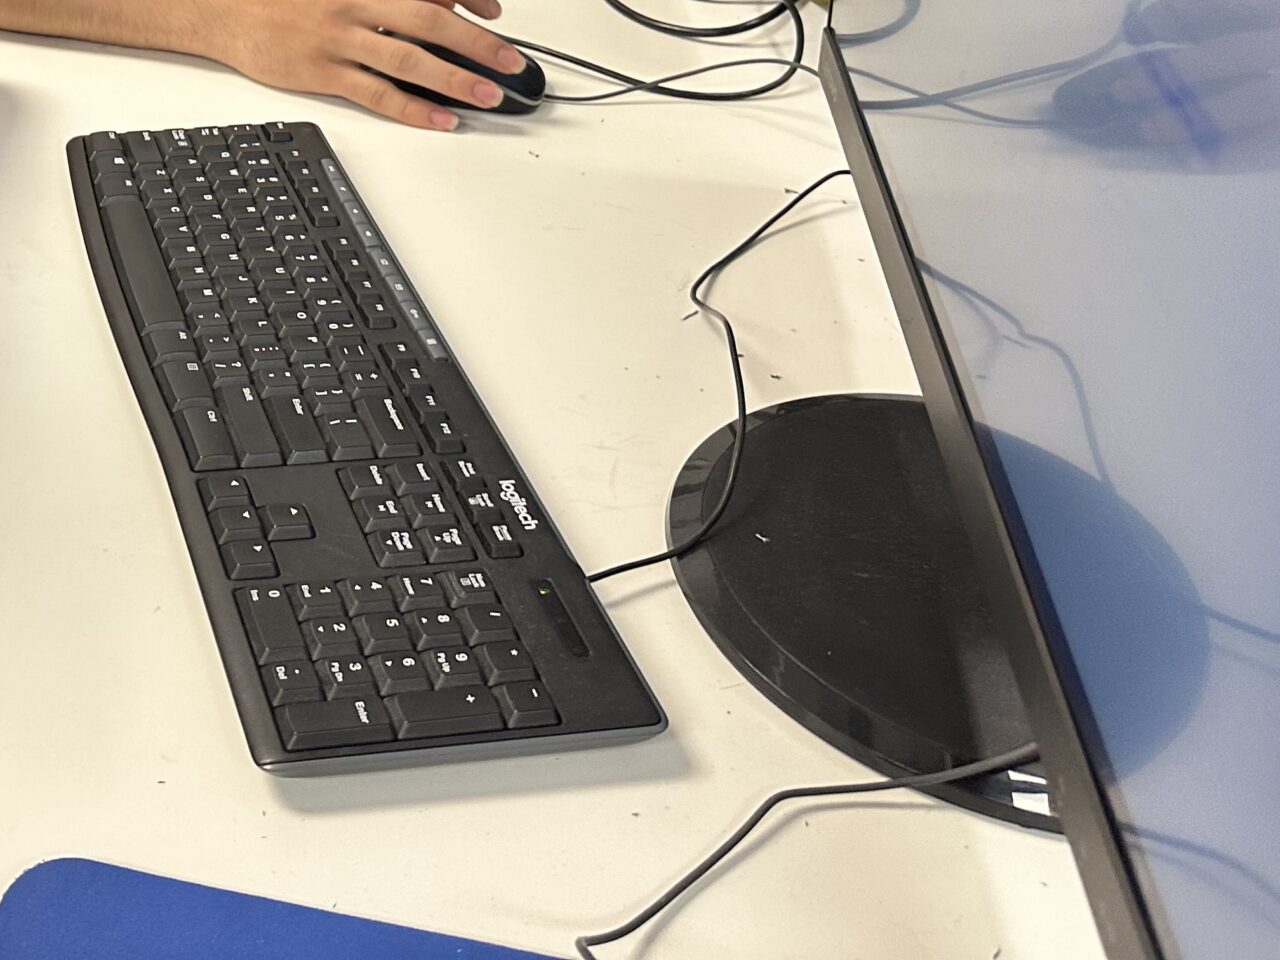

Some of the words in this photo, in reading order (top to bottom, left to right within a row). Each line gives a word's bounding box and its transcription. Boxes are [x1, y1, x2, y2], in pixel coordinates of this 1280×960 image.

[498, 480, 539, 531] logitech
[370, 582, 382, 590] 4
[420, 578, 432, 586] 7
[268, 590, 280, 598] 0
[386, 618, 400, 626] 5
[438, 614, 450, 622] 8
[332, 624, 346, 632] 2
[456, 652, 468, 662] 9
[348, 662, 362, 670] 3
[402, 658, 416, 666] 6
[276, 666, 288, 680] Del
[354, 702, 370, 724] Enter
